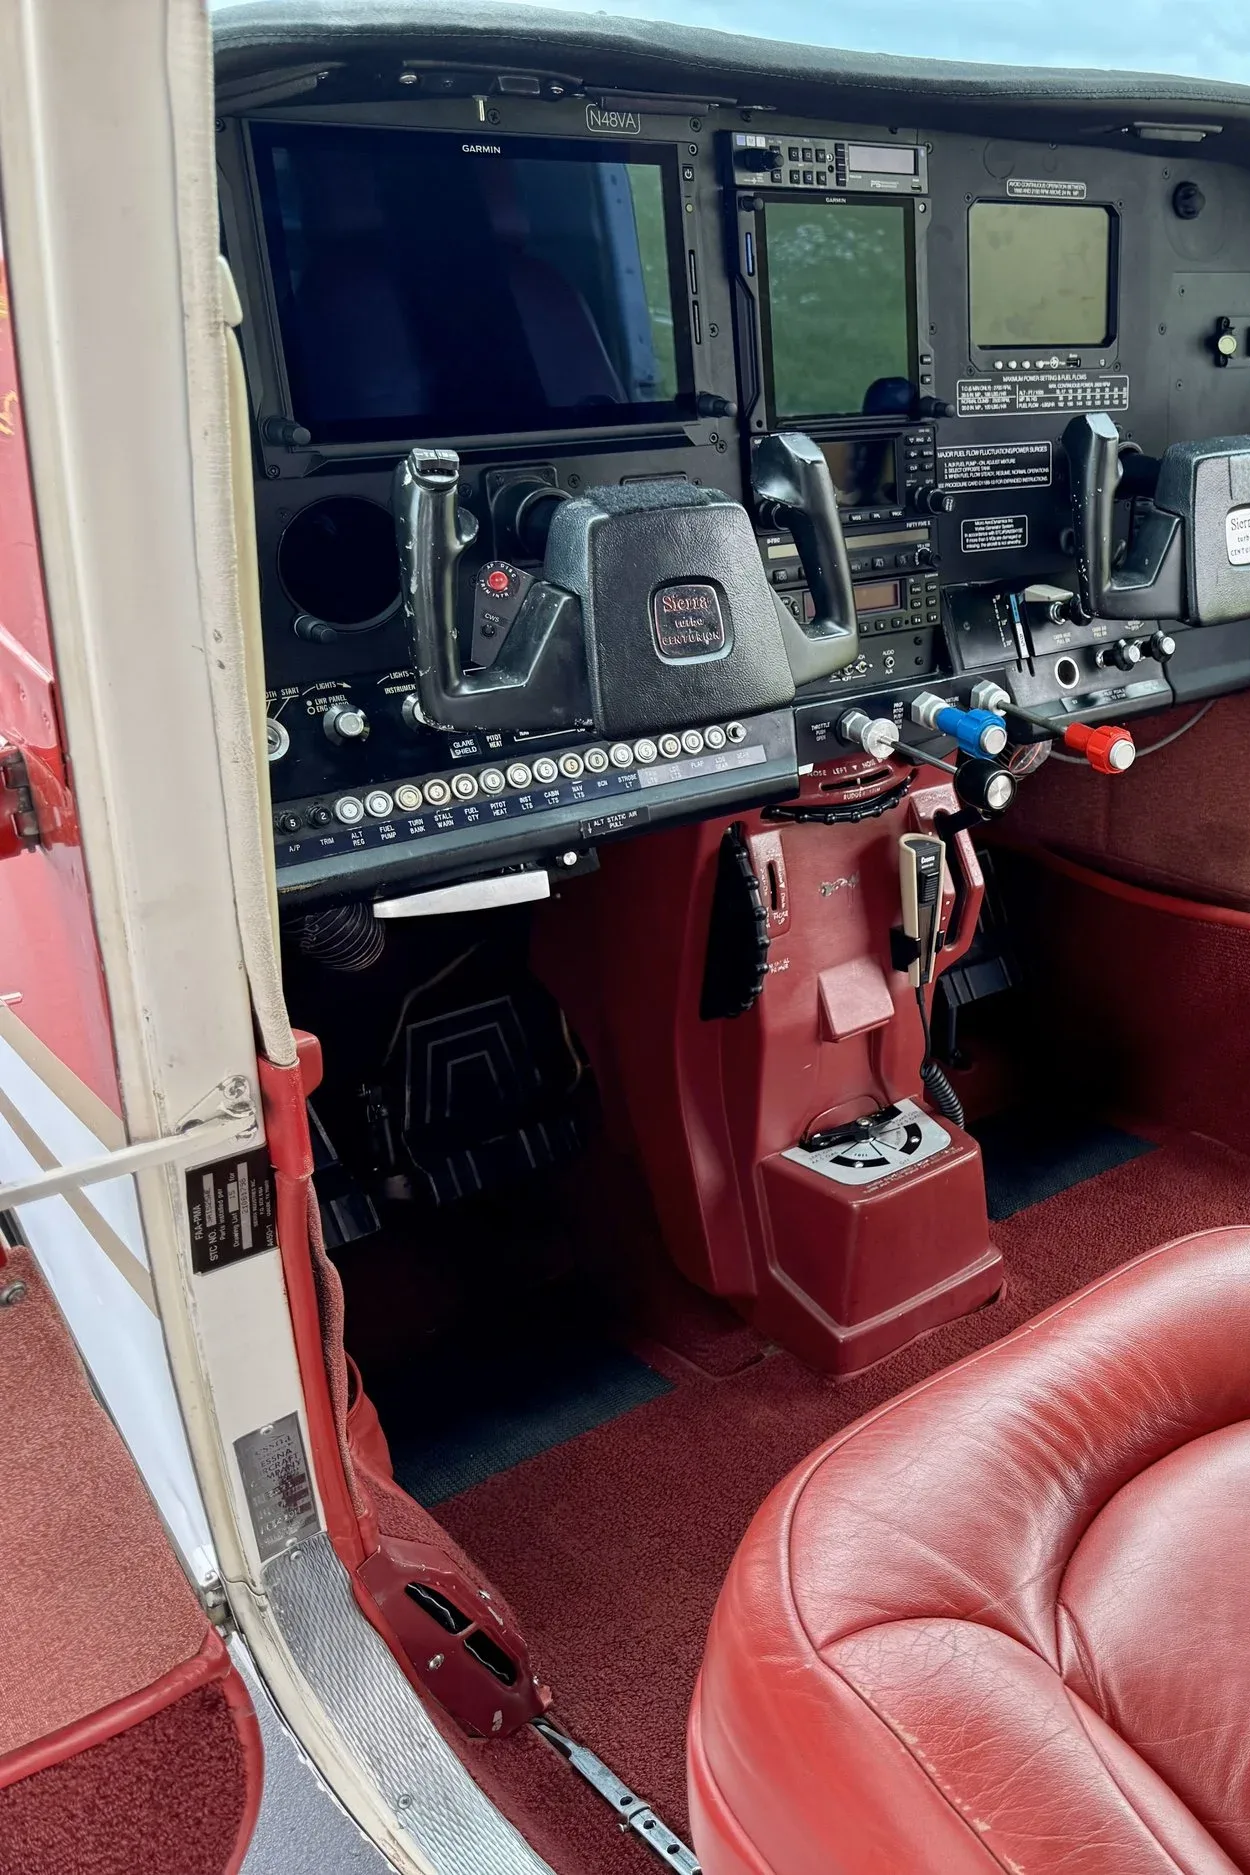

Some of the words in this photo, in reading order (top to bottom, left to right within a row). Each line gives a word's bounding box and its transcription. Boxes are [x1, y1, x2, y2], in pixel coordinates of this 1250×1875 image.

[590, 110, 637, 128] N48VA
[462, 144, 501, 154] GARMIN
[937, 451, 954, 459] MAJOR
[1029, 445, 1048, 453] SURGES
[500, 563, 517, 578] DISC
[480, 579, 491, 594] TRIM
[662, 594, 709, 614] Sierra
[484, 612, 500, 623] CWS
[662, 631, 720, 646] CENTURION
[389, 671, 410, 680] LIGHTS
[315, 682, 337, 690] LIGHTS
[384, 683, 416, 695] INSTRUMEN
[280, 686, 300, 696] START
[314, 697, 328, 706] LWR
[328, 695, 348, 703] PANEL
[811, 722, 831, 731] THROTTLE
[486, 734, 502, 743] PITOT
[453, 739, 475, 748] GLARE
[489, 740, 503, 749] HEAT
[454, 747, 478, 756] SHIELD
[645, 747, 650, 755] 5
[569, 761, 575, 769] 5
[544, 766, 550, 775] 5
[833, 766, 848, 775] LEFT
[618, 773, 637, 783] STROBE
[463, 783, 469, 791] 2
[597, 779, 608, 788] BCN
[625, 780, 633, 789] LT
[571, 785, 583, 793] NAV
[544, 790, 560, 799] CABIN
[573, 792, 585, 800] LTS
[519, 795, 532, 804] INST
[547, 796, 560, 805] LTS
[490, 800, 506, 809] PITOT
[521, 802, 534, 811] LTS
[464, 807, 479, 815] FUEL
[492, 808, 508, 817] HEAT
[320, 812, 327, 821] 2
[434, 813, 453, 822] STALL
[467, 813, 480, 822] QTY
[593, 818, 605, 827] ALT
[606, 813, 627, 823] STATIC
[628, 810, 638, 818] AIR
[290, 819, 296, 827] 5
[408, 819, 424, 827] TURN
[437, 820, 454, 829] WARN
[609, 821, 623, 829] PULL
[379, 825, 395, 834] FUEL
[410, 826, 426, 835] BANK
[351, 831, 363, 840] ALT
[381, 832, 397, 841] PUMP
[319, 837, 335, 846] TRIM
[353, 838, 365, 847] REG
[289, 844, 301, 853] A/P
[228, 1189, 236, 1200] 15
[217, 1199, 225, 1225] installed
[192, 1203, 205, 1241] FAA-PMA
[207, 1229, 218, 1244] NO.
[218, 1224, 226, 1241] Parts
[232, 1224, 240, 1248] Drawing
[208, 1244, 219, 1262] STC
[261, 1448, 292, 1468] ESSNA
[262, 1454, 299, 1474] RCRAFT
[266, 1460, 301, 1480] MPANY
